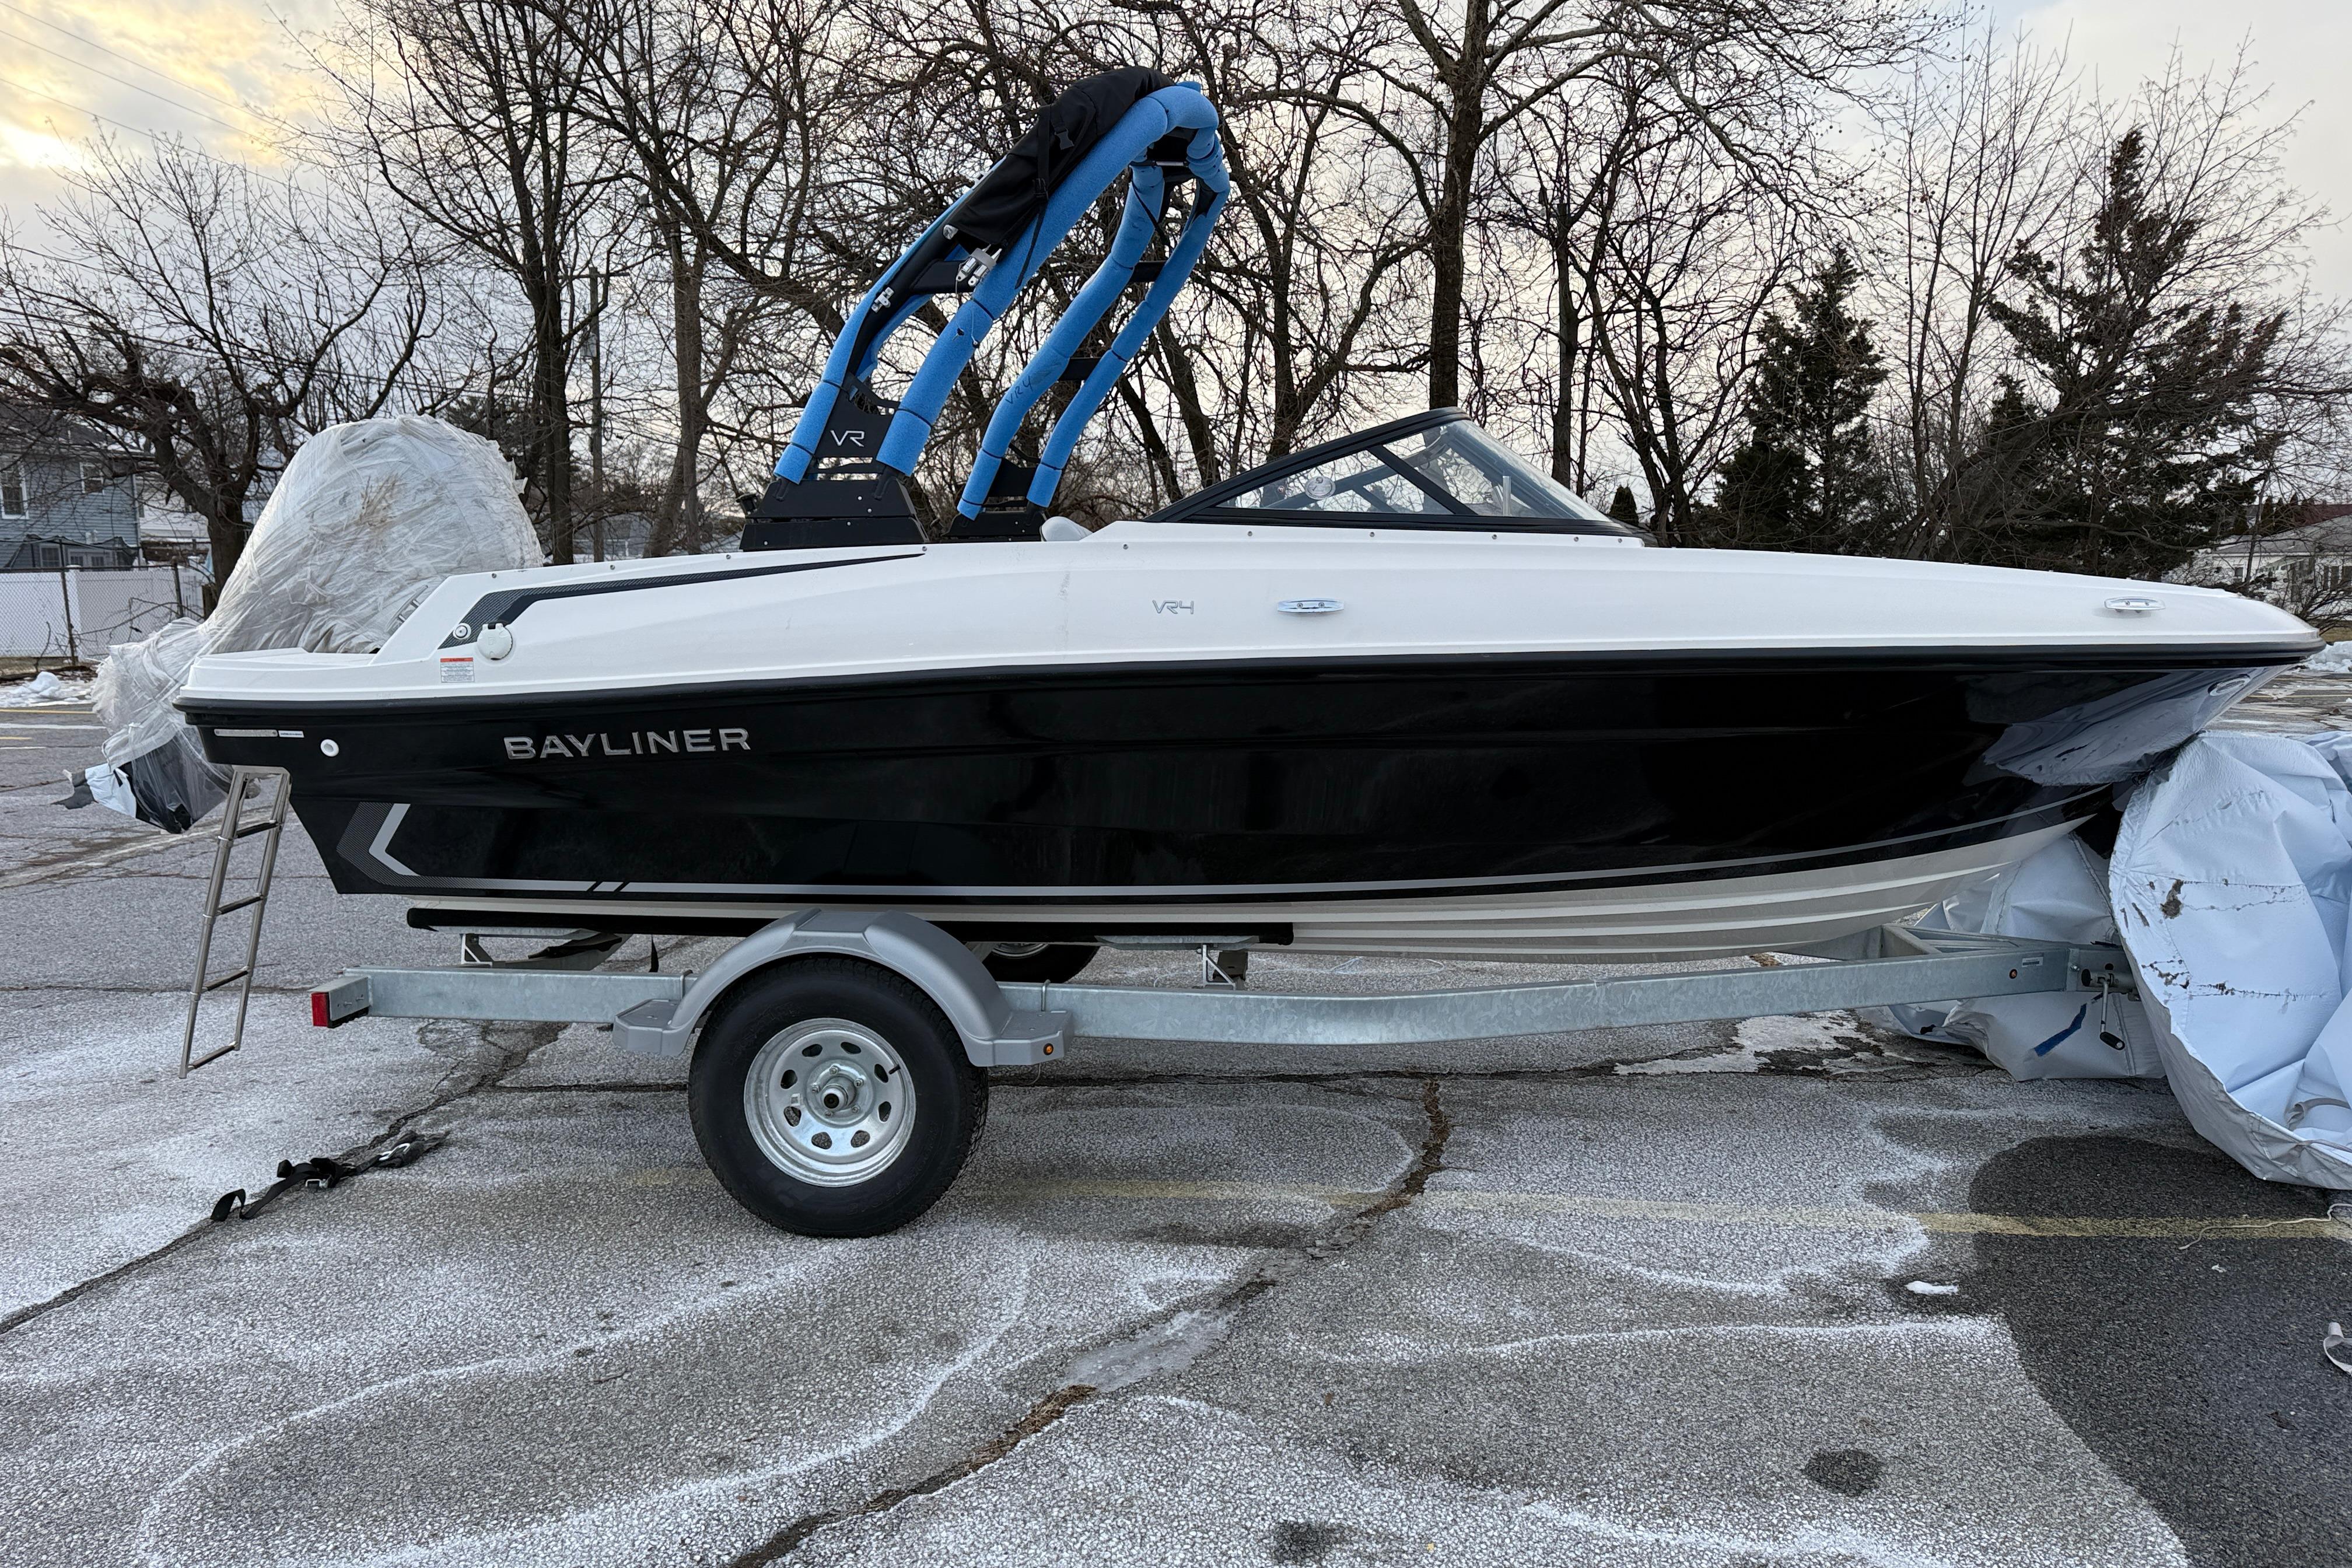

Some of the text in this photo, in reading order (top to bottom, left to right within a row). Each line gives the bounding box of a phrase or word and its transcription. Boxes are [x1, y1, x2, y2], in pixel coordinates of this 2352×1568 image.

[830, 429, 864, 447] VR
[1152, 600, 1194, 614] VR4
[503, 727, 751, 760] BAYLINER
